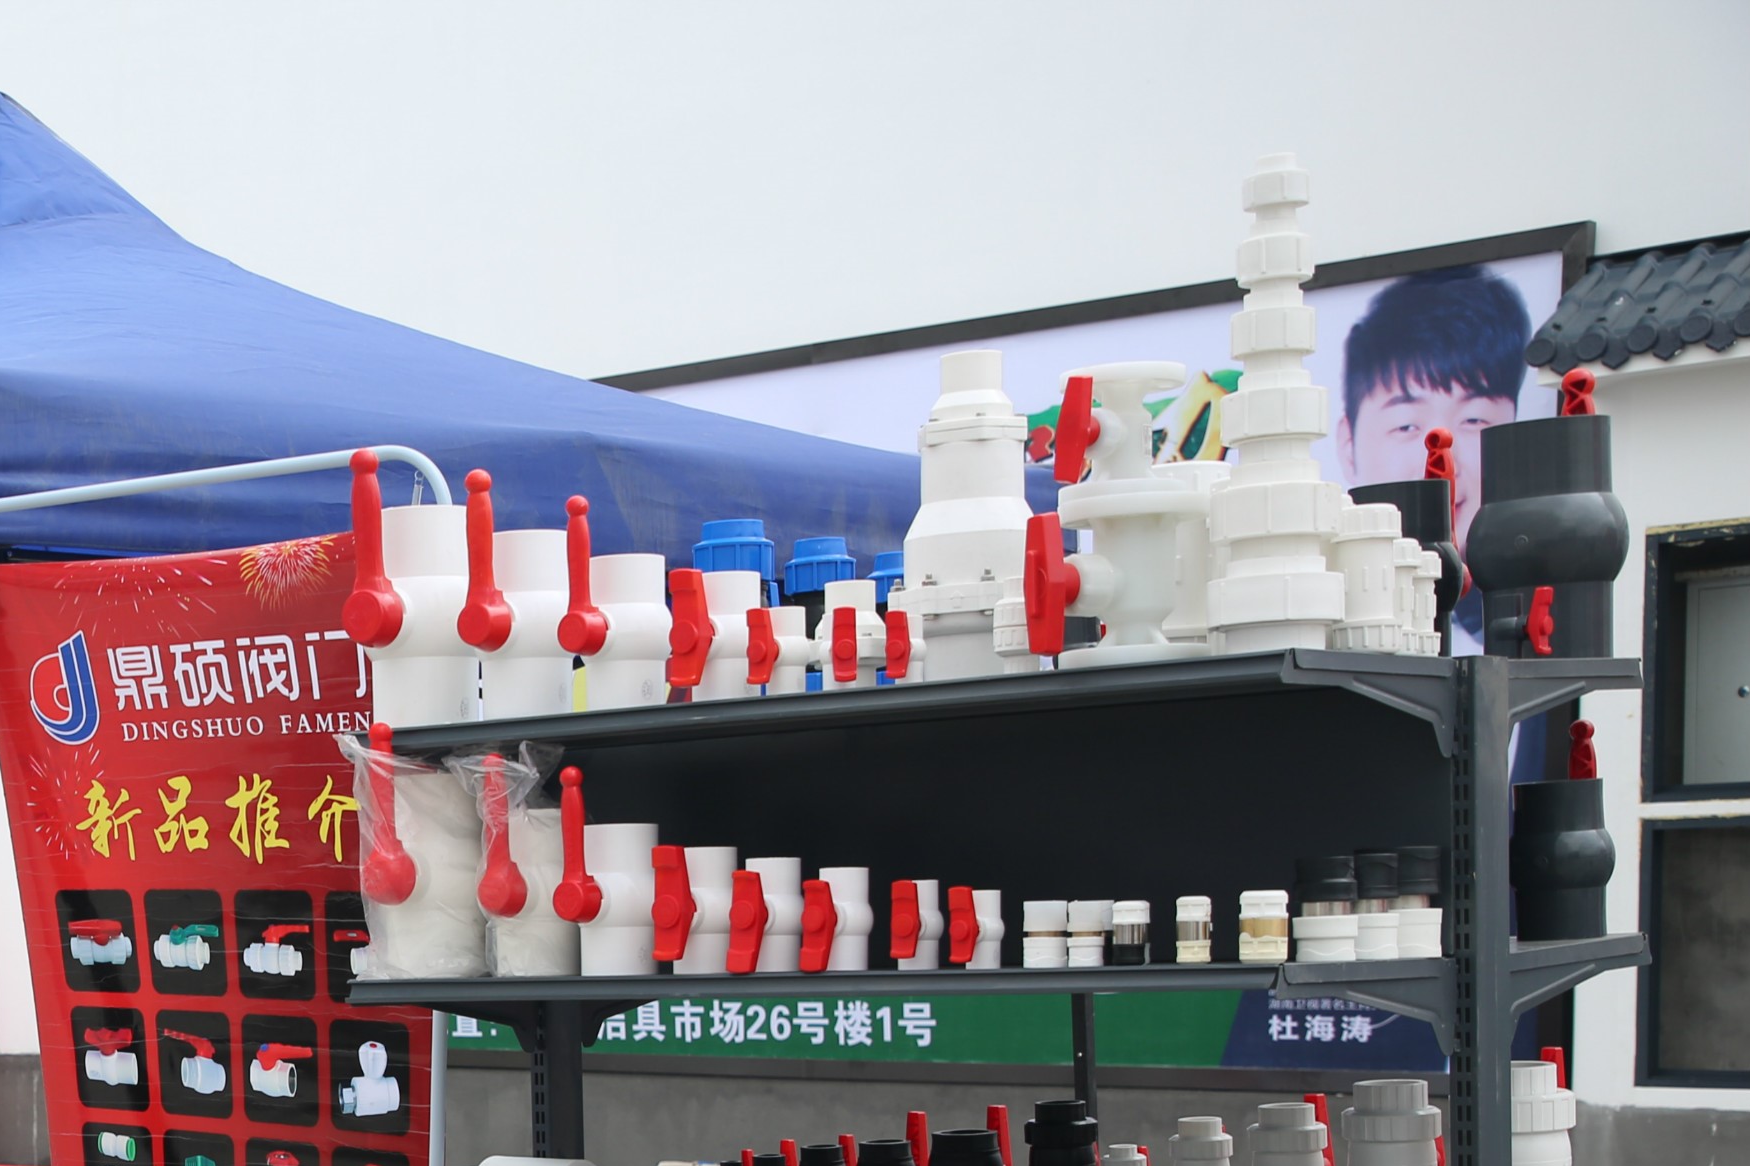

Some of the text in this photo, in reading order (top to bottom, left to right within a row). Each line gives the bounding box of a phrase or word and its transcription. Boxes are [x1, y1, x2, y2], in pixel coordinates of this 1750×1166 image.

[107, 630, 373, 712] 鼎硕阀门
[121, 711, 371, 742] DINGSHUO FAMEN
[75, 773, 362, 865] 新品推介
[1268, 1014, 1373, 1043] 杜海涛
